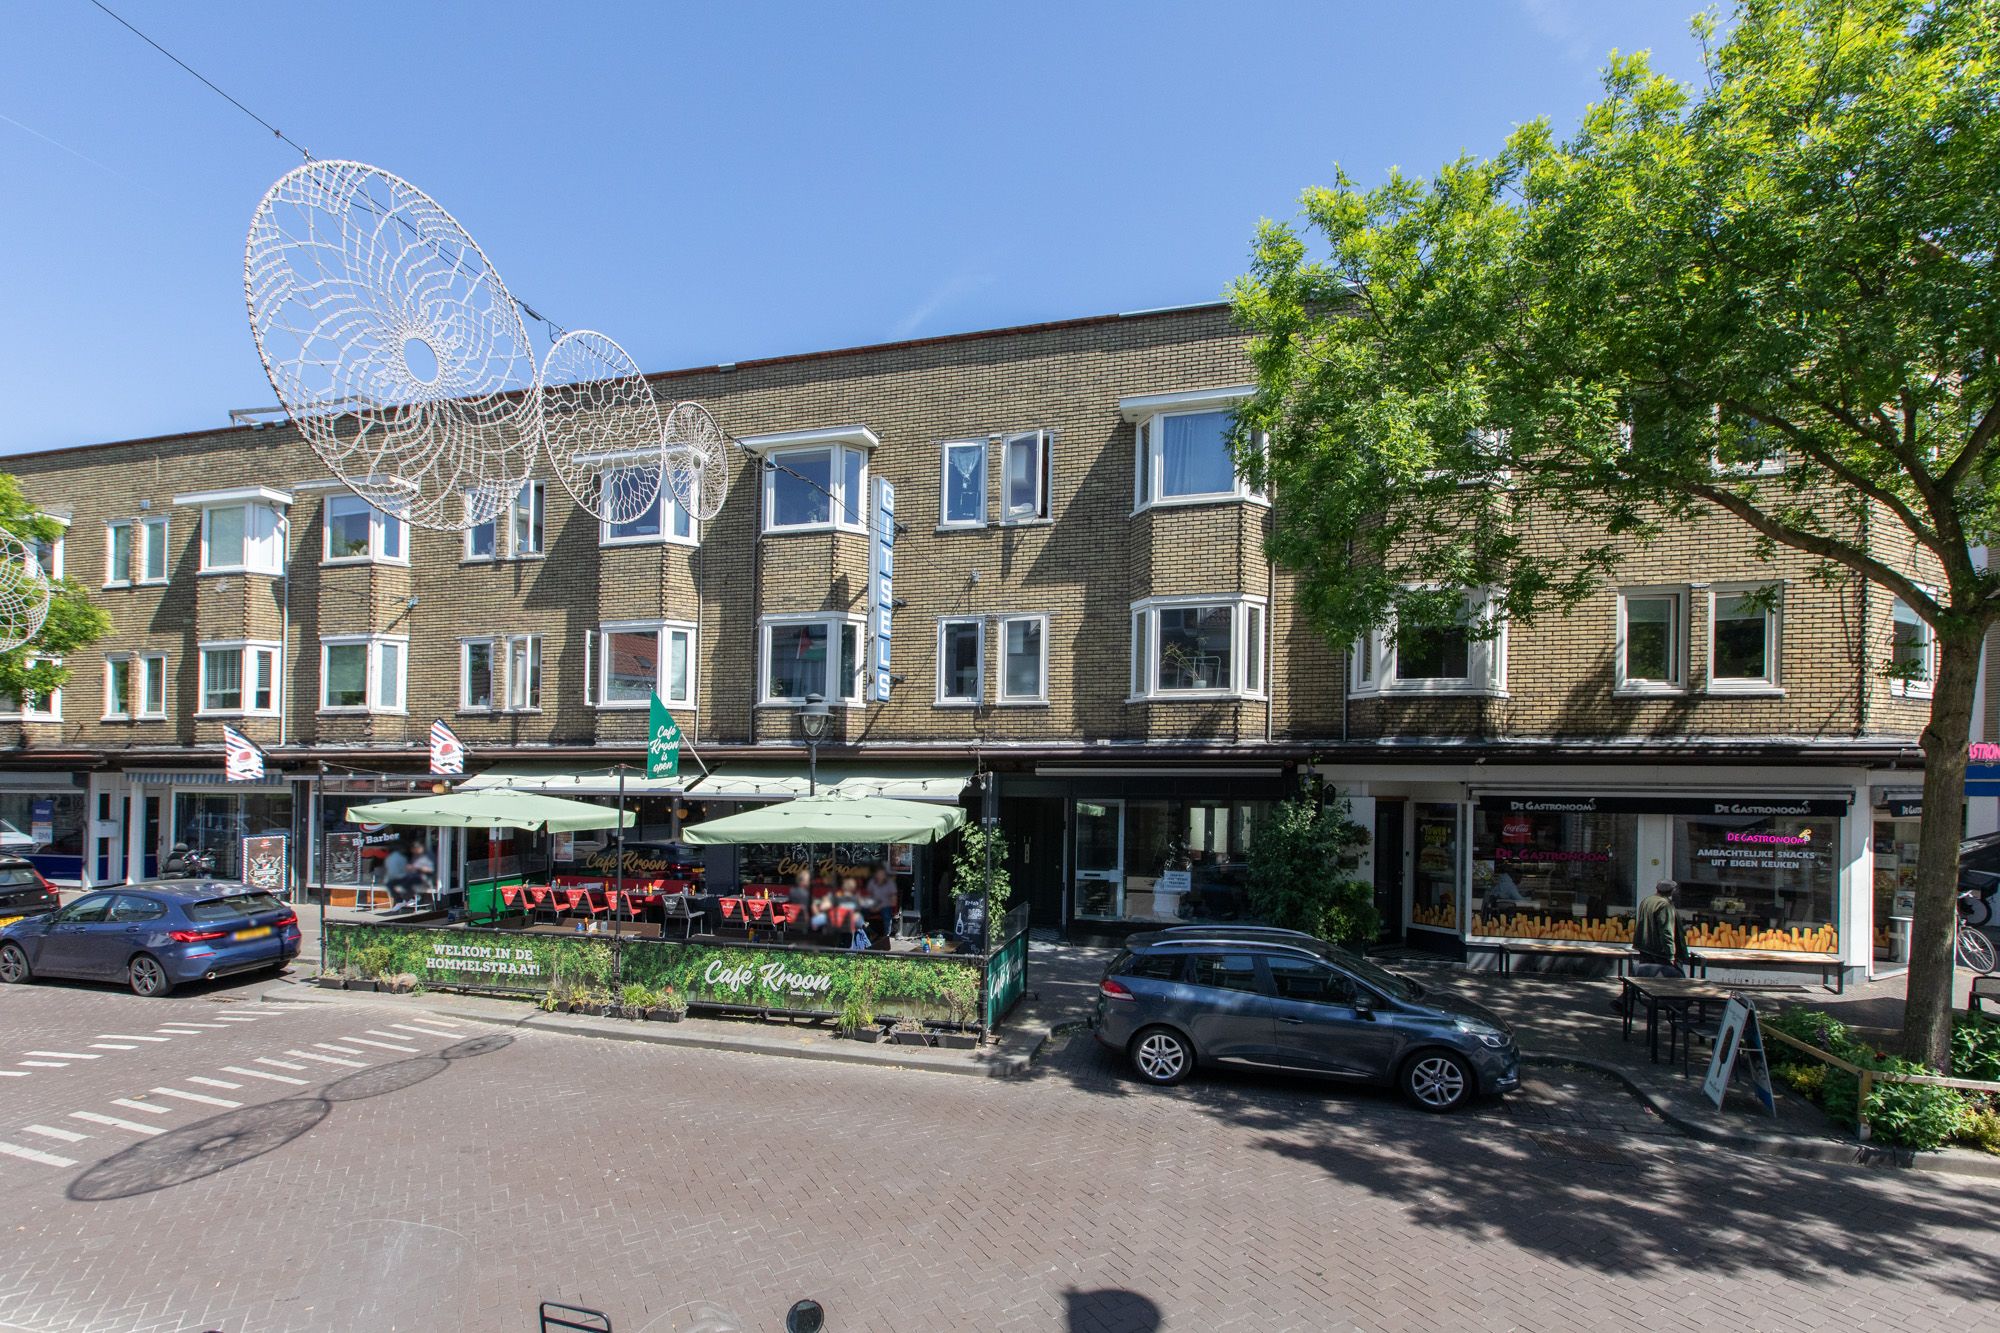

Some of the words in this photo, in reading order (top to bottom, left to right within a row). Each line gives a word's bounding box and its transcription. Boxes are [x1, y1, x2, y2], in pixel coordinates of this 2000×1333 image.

[878, 483, 894, 698] GITSELS
[657, 725, 677, 740] Café
[649, 738, 679, 754] Kroon
[661, 752, 668, 761] is
[653, 761, 673, 774] open
[352, 838, 365, 847] By
[365, 832, 400, 844] Barber
[586, 852, 619, 873] Café
[623, 850, 668, 873] Kroon
[1697, 849, 1774, 858] AMBACHTELIJKE
[1777, 851, 1815, 859] SNACKS
[1761, 860, 1800, 869] KEUKEN
[432, 944, 491, 958] WELKOM
[495, 947, 511, 959] IN
[515, 948, 533, 961] DE
[426, 957, 540, 976] HOMMELSTRAAT!
[705, 959, 755, 992] Café
[759, 962, 832, 992] Kroon
